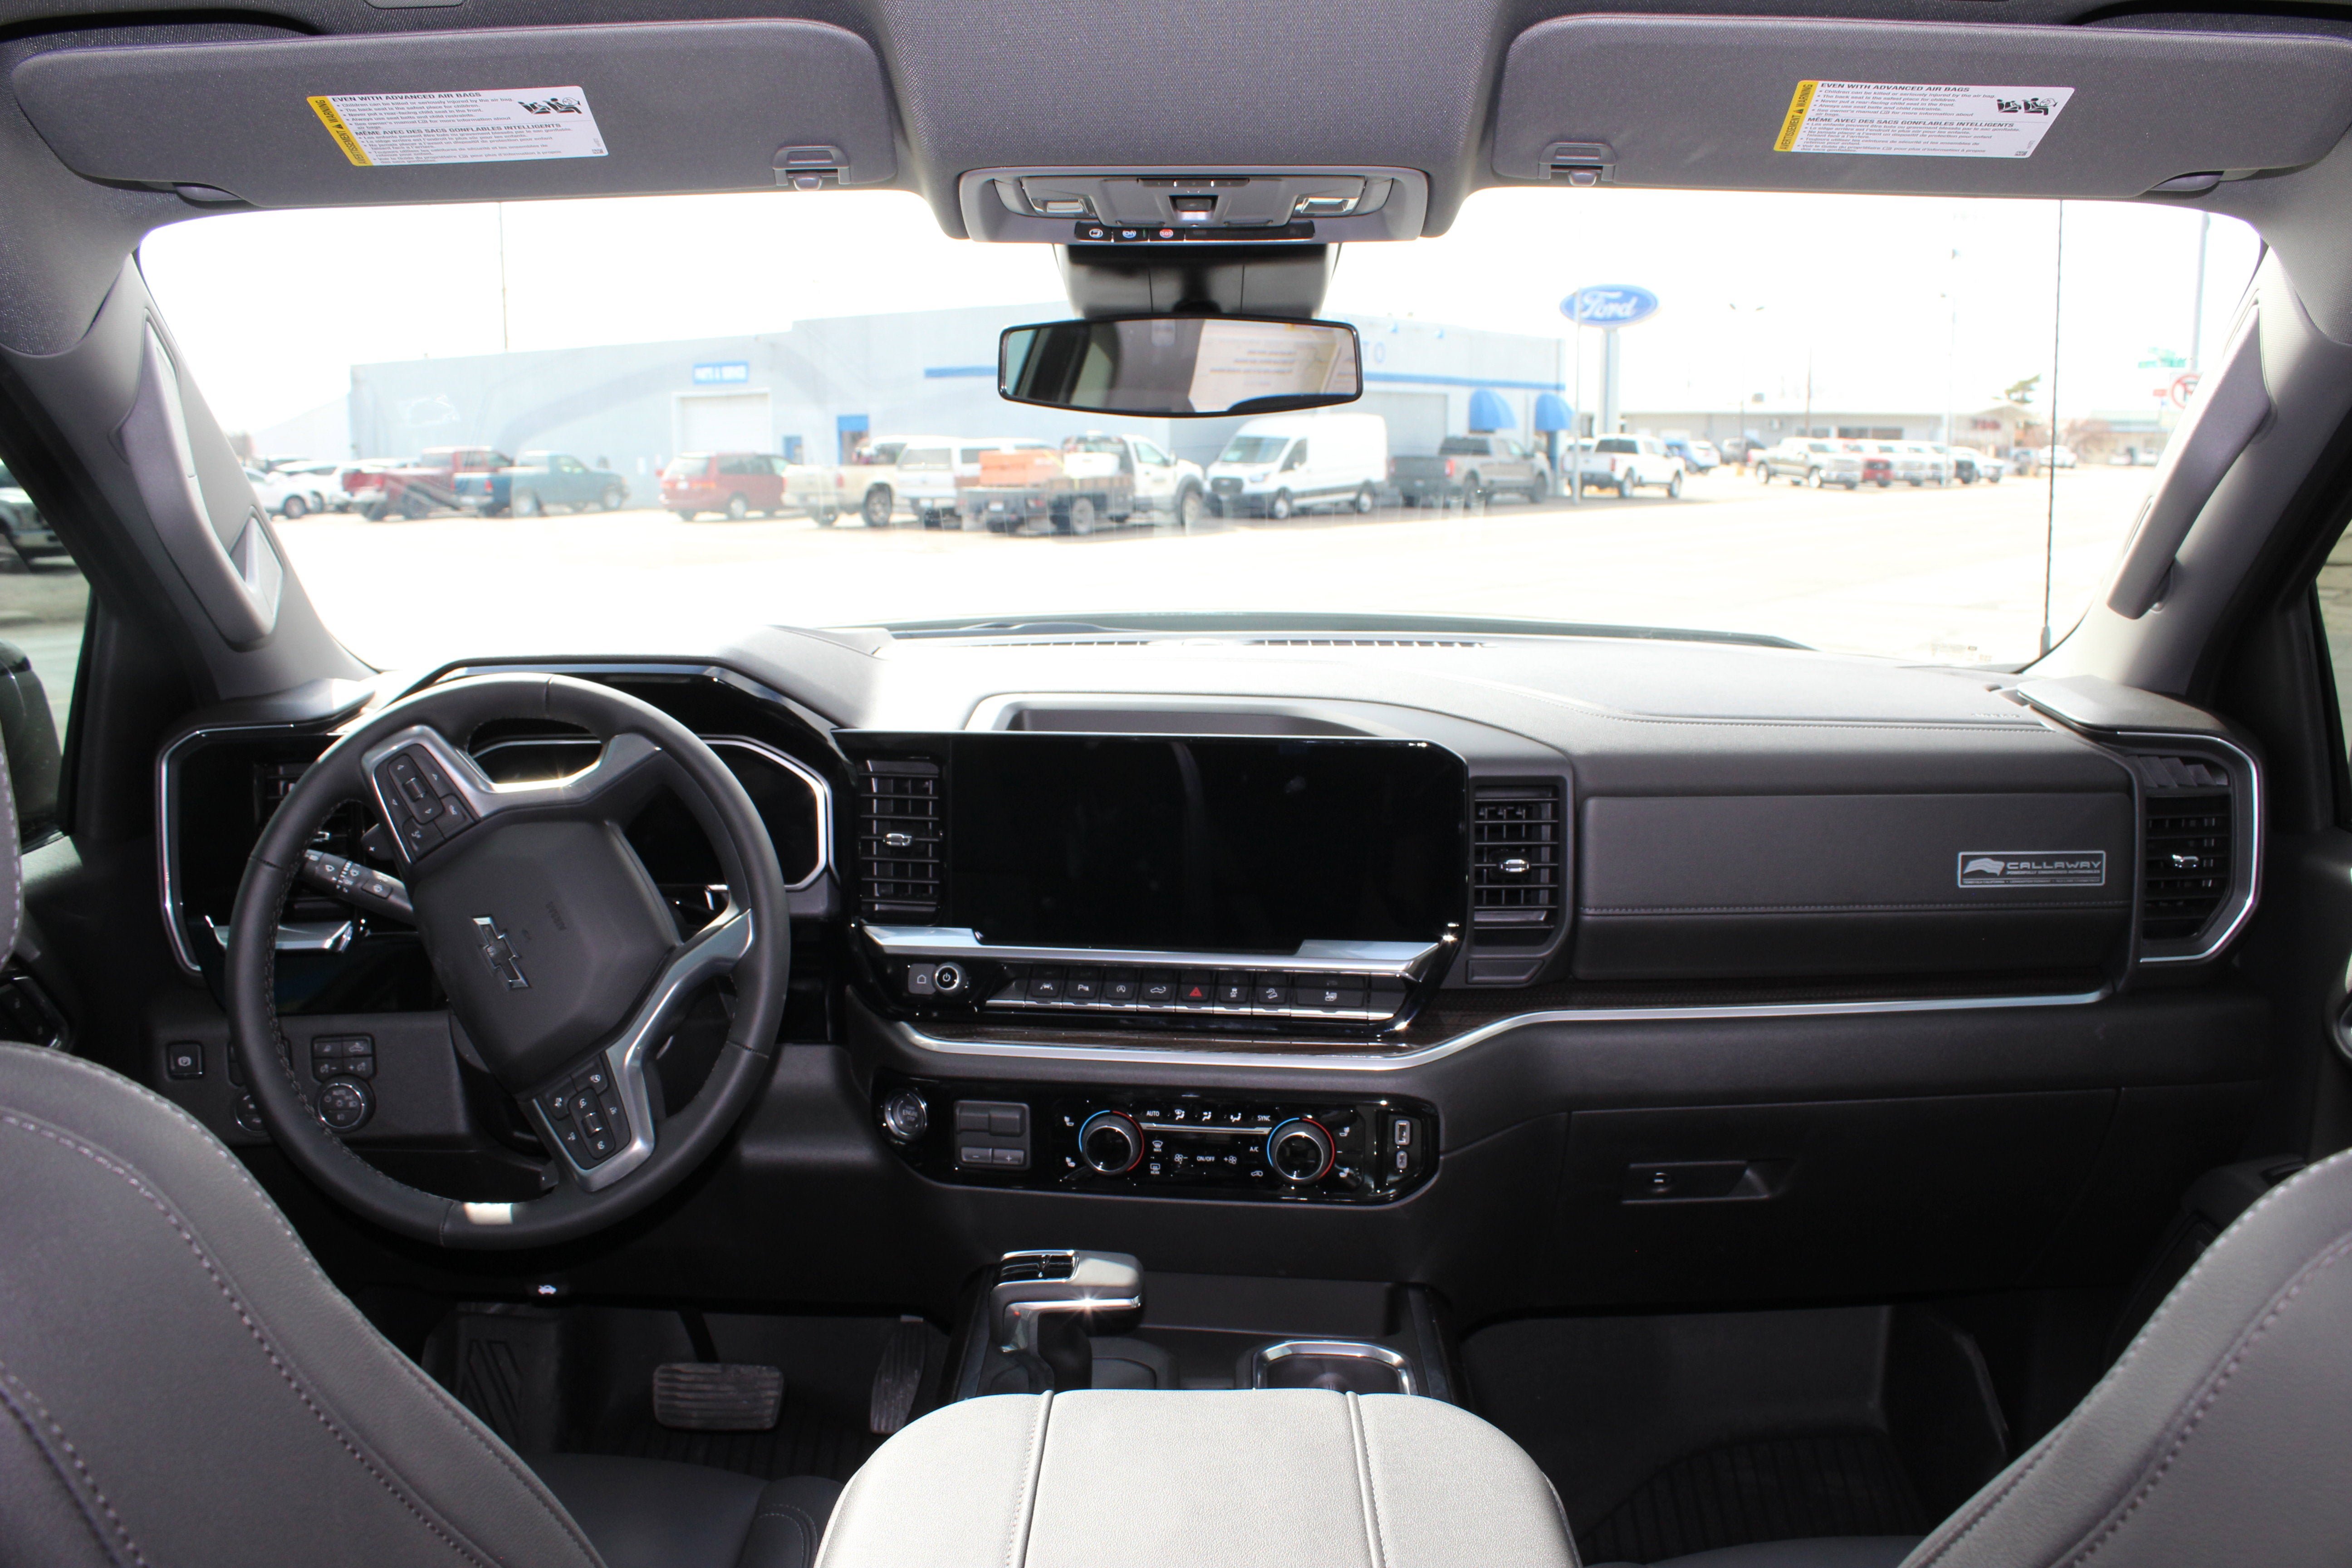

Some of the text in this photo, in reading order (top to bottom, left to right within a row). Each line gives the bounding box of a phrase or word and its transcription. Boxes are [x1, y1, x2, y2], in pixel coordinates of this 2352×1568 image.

[1796, 83, 1813, 107] WARNING
[315, 99, 337, 126] WARNING
[1580, 291, 1637, 319] Ford
[2007, 861, 2102, 869] CALLAWAY
